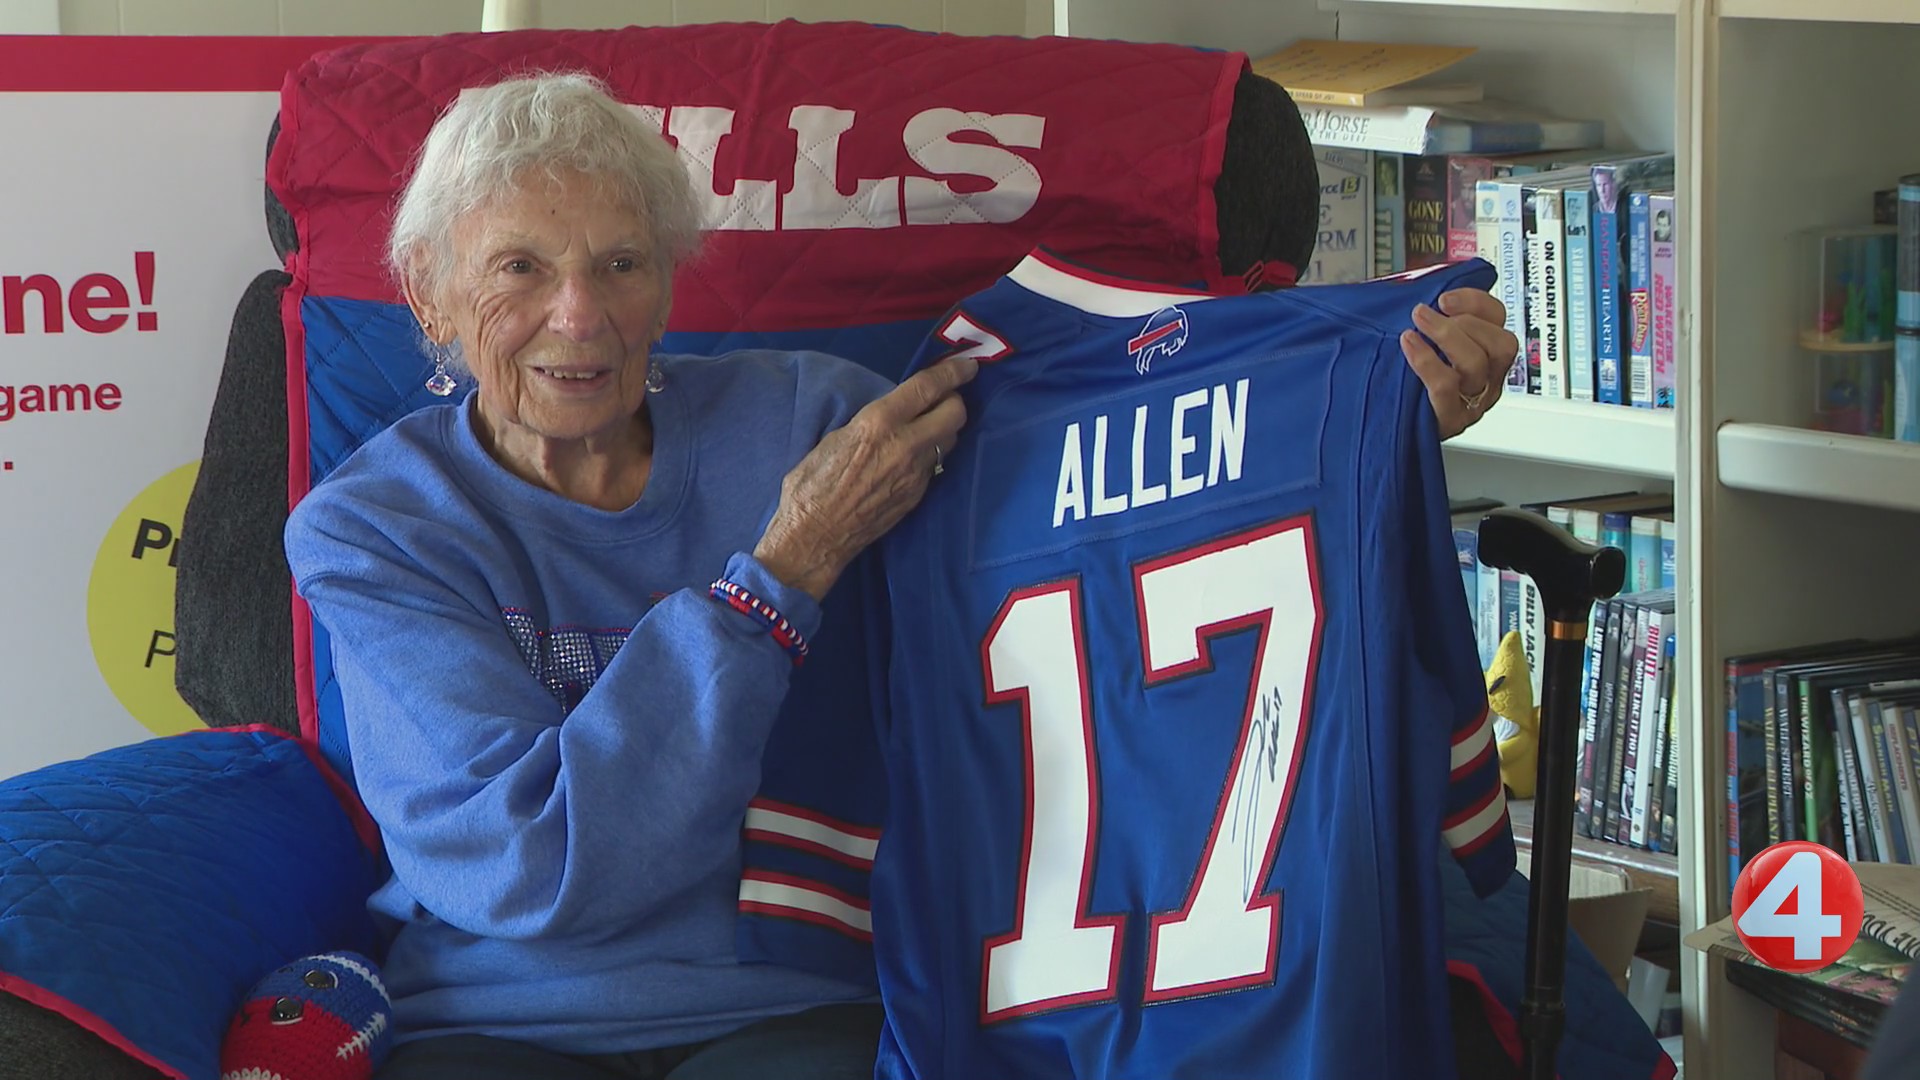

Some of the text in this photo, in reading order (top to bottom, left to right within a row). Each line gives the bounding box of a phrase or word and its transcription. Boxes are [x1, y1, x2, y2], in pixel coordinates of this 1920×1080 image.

[1314, 109, 1370, 134] HORSE
[570, 104, 1046, 231] LLS
[1409, 200, 1444, 222] GONE
[1409, 233, 1445, 254] WIND
[1502, 231, 1516, 282] GRUMPY
[2, 251, 159, 334] ne!
[1504, 284, 1516, 309] OLD
[1525, 230, 1541, 330] JURASSIC PARK
[1544, 241, 1558, 362] ON GOLDEN POND
[1602, 288, 1613, 354] HEARTS
[1655, 273, 1665, 373] RED WITCH
[0, 381, 122, 422] game
[1052, 378, 1249, 528] ALLEN
[1509, 609, 1518, 632] YAN
[1526, 584, 1536, 629] BILLY
[1593, 627, 1604, 651] LIVE
[1645, 625, 1660, 680] BULLITT
[1590, 652, 1602, 679] FREE
[1588, 690, 1598, 708] DIE
[1627, 660, 1644, 758] SOME LIKE IT HOT
[1801, 696, 1809, 714] THE
[1585, 709, 1597, 741] HARD
[1616, 722, 1625, 736] TO
[1801, 716, 1812, 767] WIZARD
[980, 509, 1327, 1027] 17
[1611, 738, 1623, 794] REMEMBER
[1779, 708, 1792, 799] WALL STREET
[1872, 724, 1894, 813] SPANISH MAIN
[1804, 781, 1813, 799] OZ
[1844, 748, 1865, 829] THUNDERBALL
